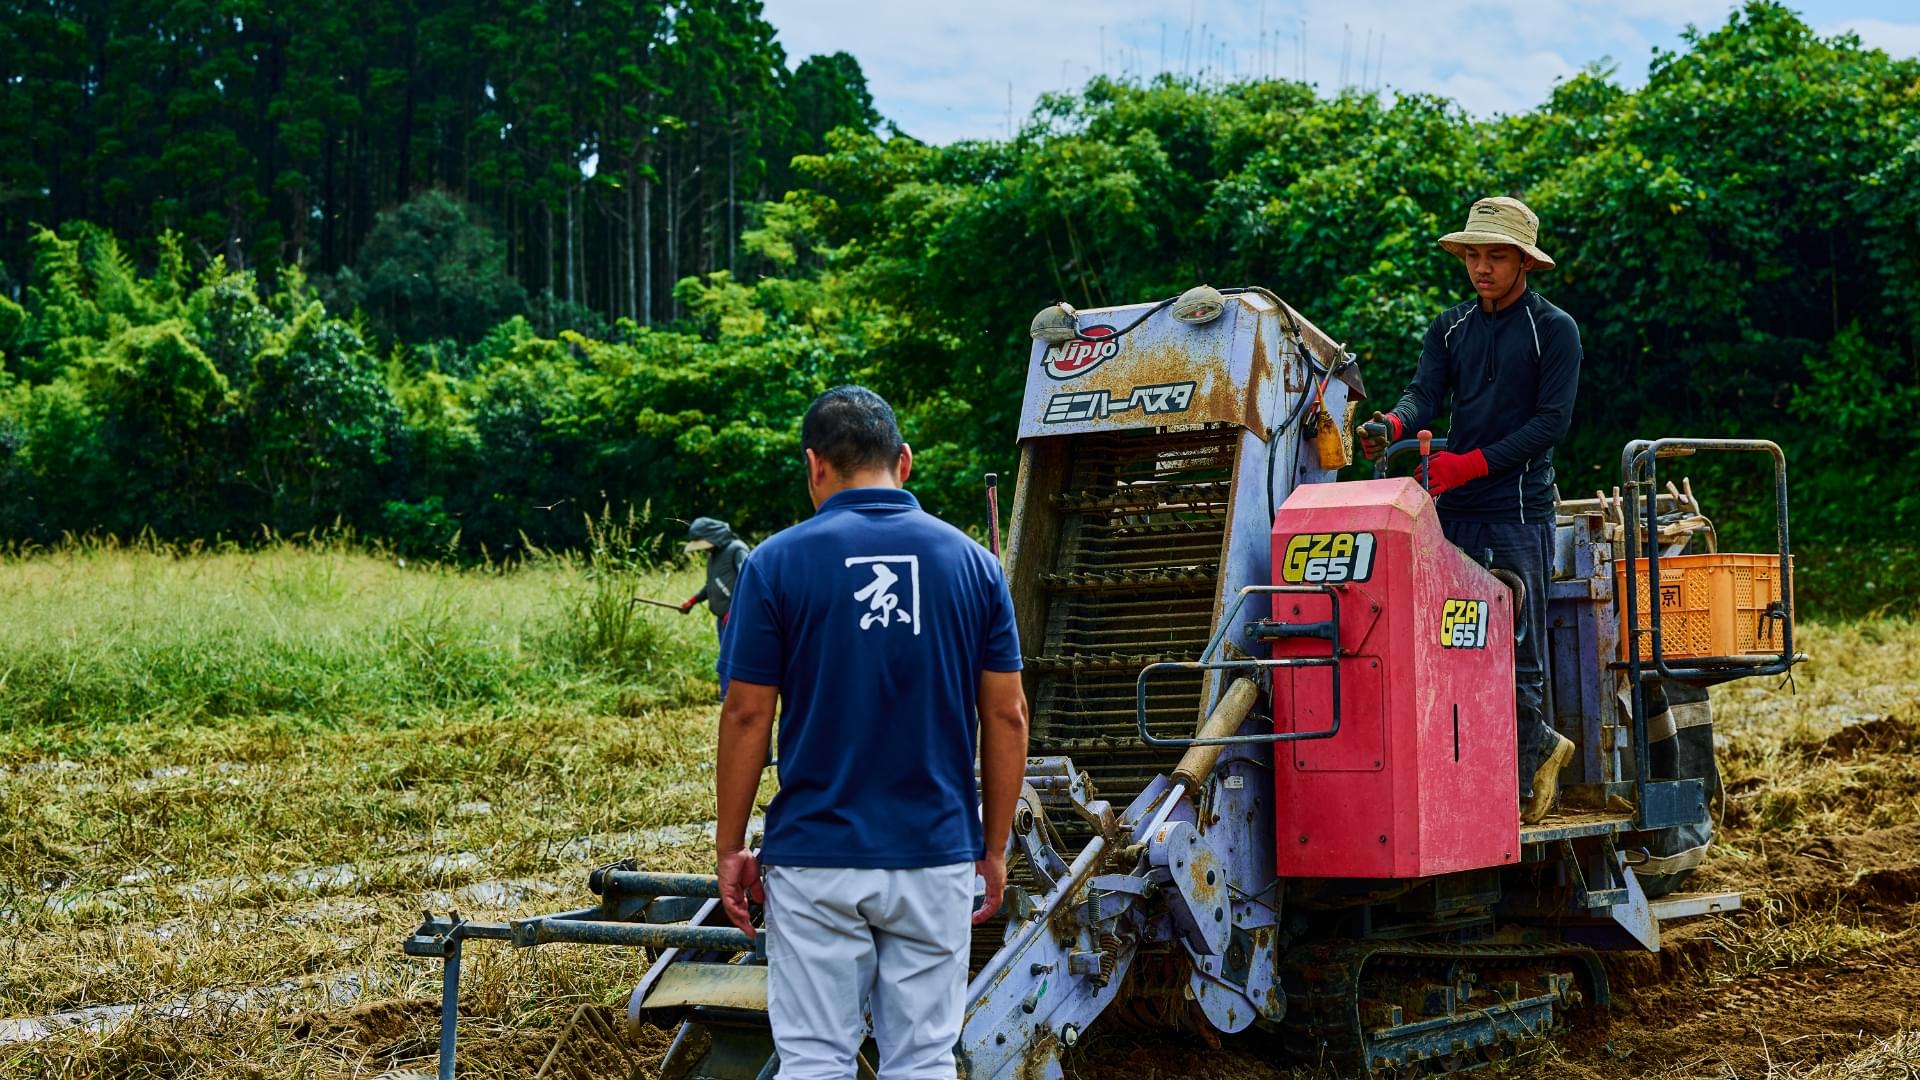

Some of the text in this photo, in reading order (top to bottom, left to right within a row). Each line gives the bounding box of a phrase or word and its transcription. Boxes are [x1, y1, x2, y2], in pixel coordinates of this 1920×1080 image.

[1047, 385, 1191, 421] ミニハーベスタ
